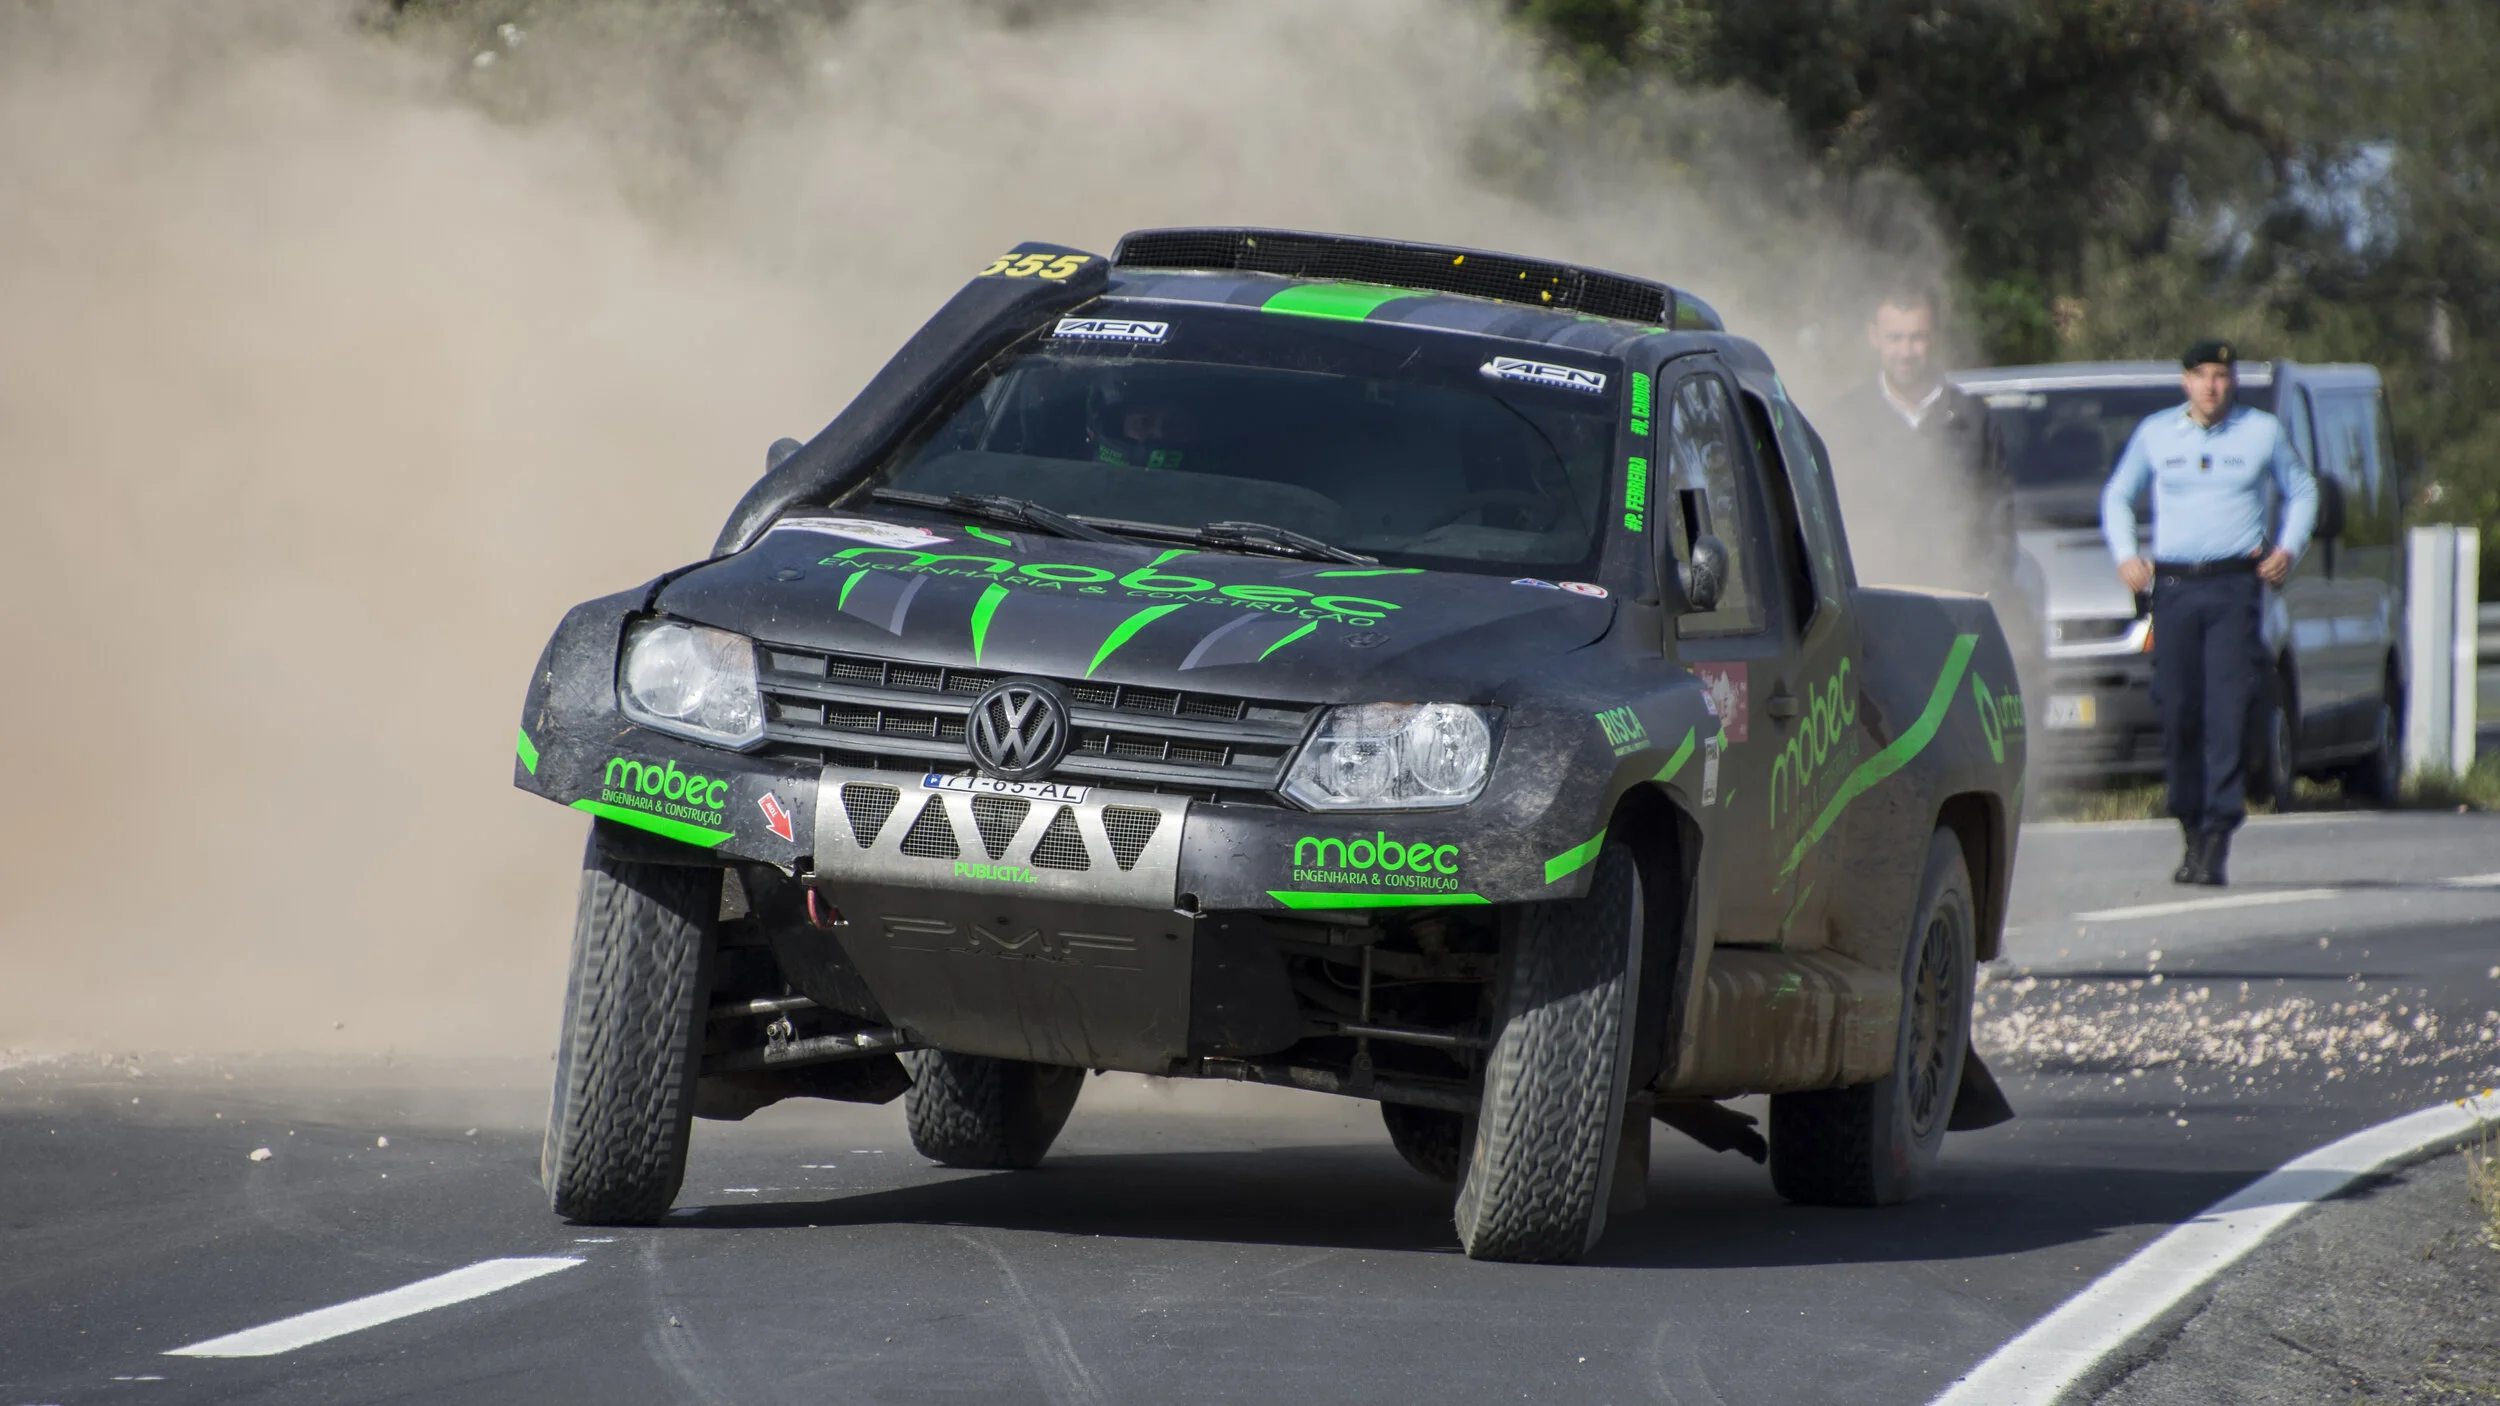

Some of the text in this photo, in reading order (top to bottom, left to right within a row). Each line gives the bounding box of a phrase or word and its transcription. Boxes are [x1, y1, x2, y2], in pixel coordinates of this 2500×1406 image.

[979, 253, 1090, 278] 555
[1063, 321, 1163, 335] AFN
[1498, 362, 1603, 386] AFN
[1624, 457, 1648, 532] #P. FERREIRA
[818, 557, 1061, 591] ENGENHARIA
[1078, 586, 1108, 594] &
[833, 547, 1402, 618] mobec
[1595, 705, 1648, 746] RISCA
[1771, 656, 1856, 830] mobec
[604, 757, 729, 809] mobec
[602, 788, 723, 826] ENGENHARIA & CONSTRUÇÃO
[1294, 831, 1459, 875] mobec
[1293, 869, 1368, 885] ENGENHARIA
[1371, 873, 1380, 885] &
